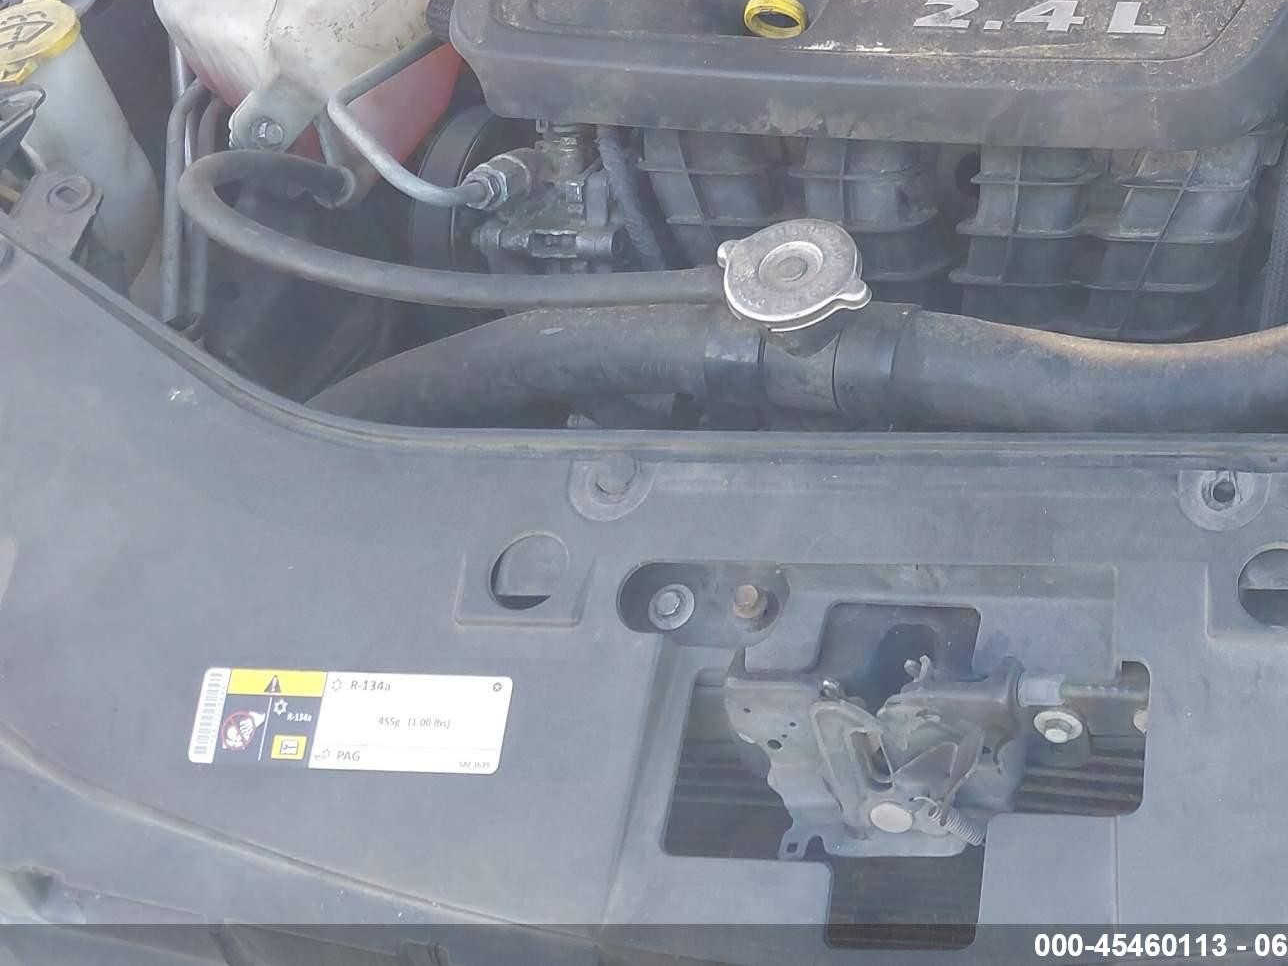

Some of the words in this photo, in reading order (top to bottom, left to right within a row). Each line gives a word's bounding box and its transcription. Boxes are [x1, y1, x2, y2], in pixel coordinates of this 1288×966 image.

[1106, 1, 1169, 35] L
[350, 680, 391, 691] R-134a
[287, 713, 312, 722] R-134a
[336, 750, 361, 762] PAG
